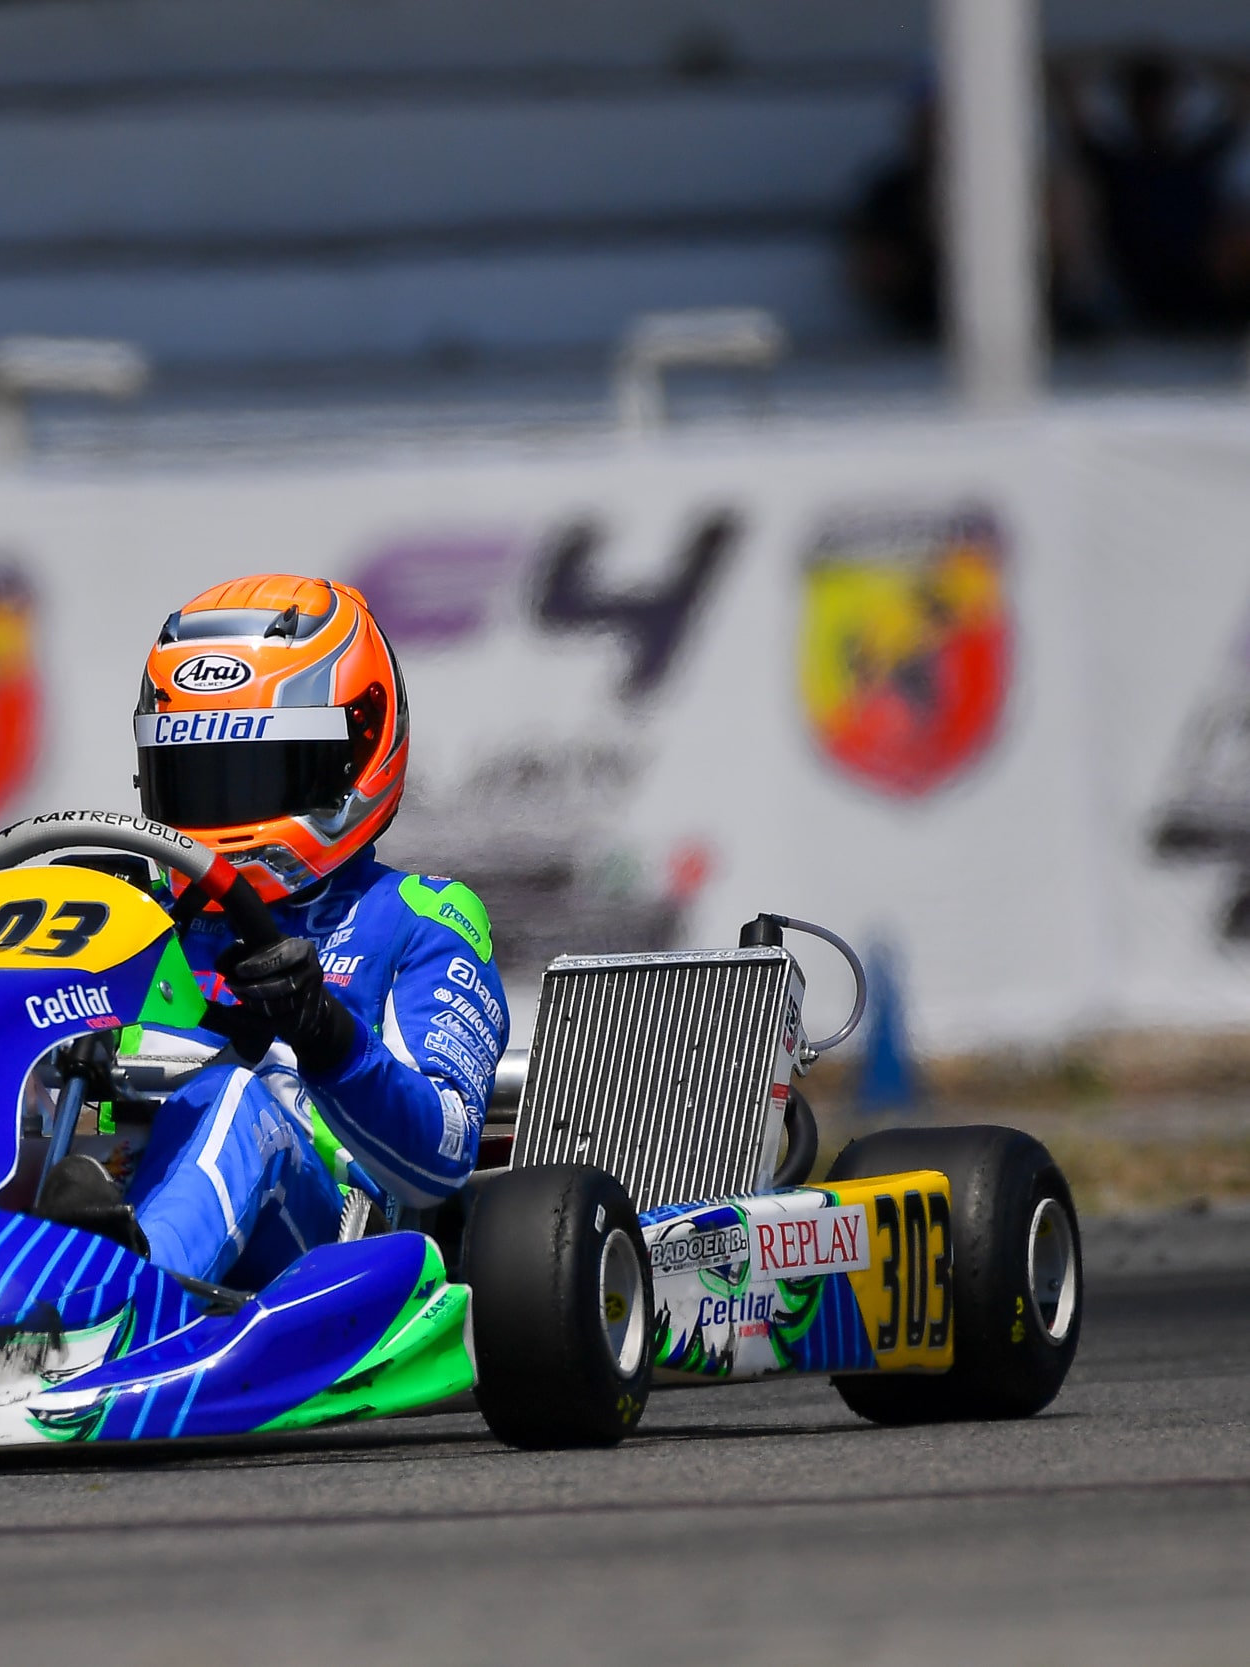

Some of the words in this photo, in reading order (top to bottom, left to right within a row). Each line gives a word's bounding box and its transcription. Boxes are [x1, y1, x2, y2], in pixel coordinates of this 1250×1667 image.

[178, 659, 240, 681] Arai
[155, 712, 275, 744] Cetilar
[25, 984, 113, 1029] Cetilar
[650, 1231, 726, 1268] BADOER
[727, 1228, 747, 1253] B.
[756, 1215, 860, 1271] REPLAY
[875, 1190, 950, 1353] 303
[700, 1292, 775, 1327] Cetilar
